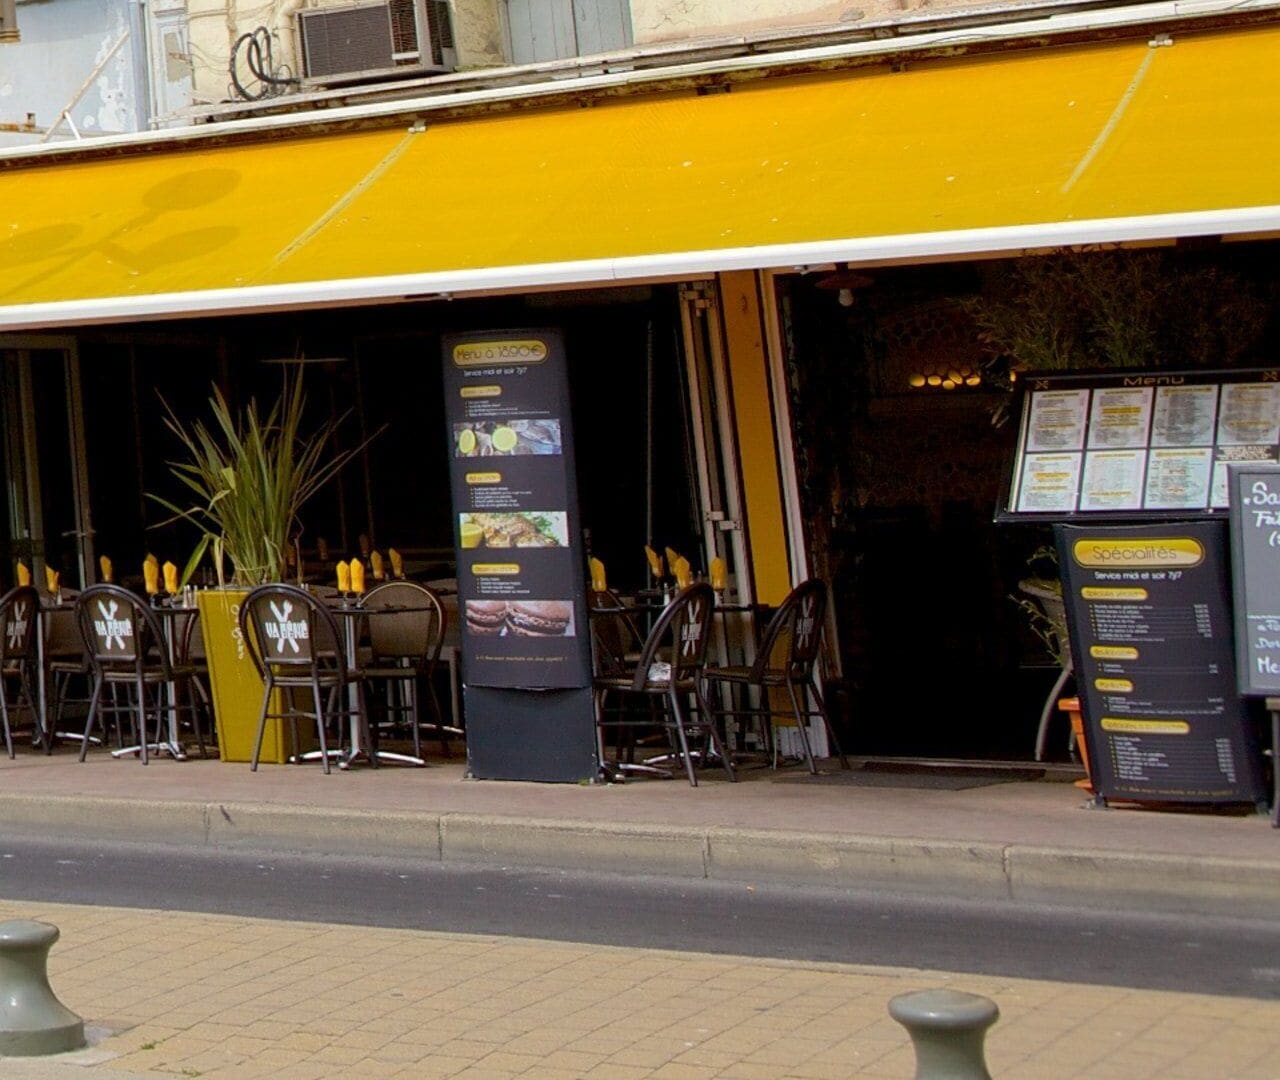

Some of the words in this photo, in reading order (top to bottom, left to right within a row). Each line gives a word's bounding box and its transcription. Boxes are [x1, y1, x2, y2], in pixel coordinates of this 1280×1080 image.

[456, 348, 482, 360] Menu
[1123, 375, 1184, 386] Menu
[1092, 545, 1177, 562] Spécialités
[1094, 571, 1121, 580] Service
[1123, 571, 1139, 580] midi
[1141, 571, 1149, 579] et
[1152, 571, 1166, 580] soir
